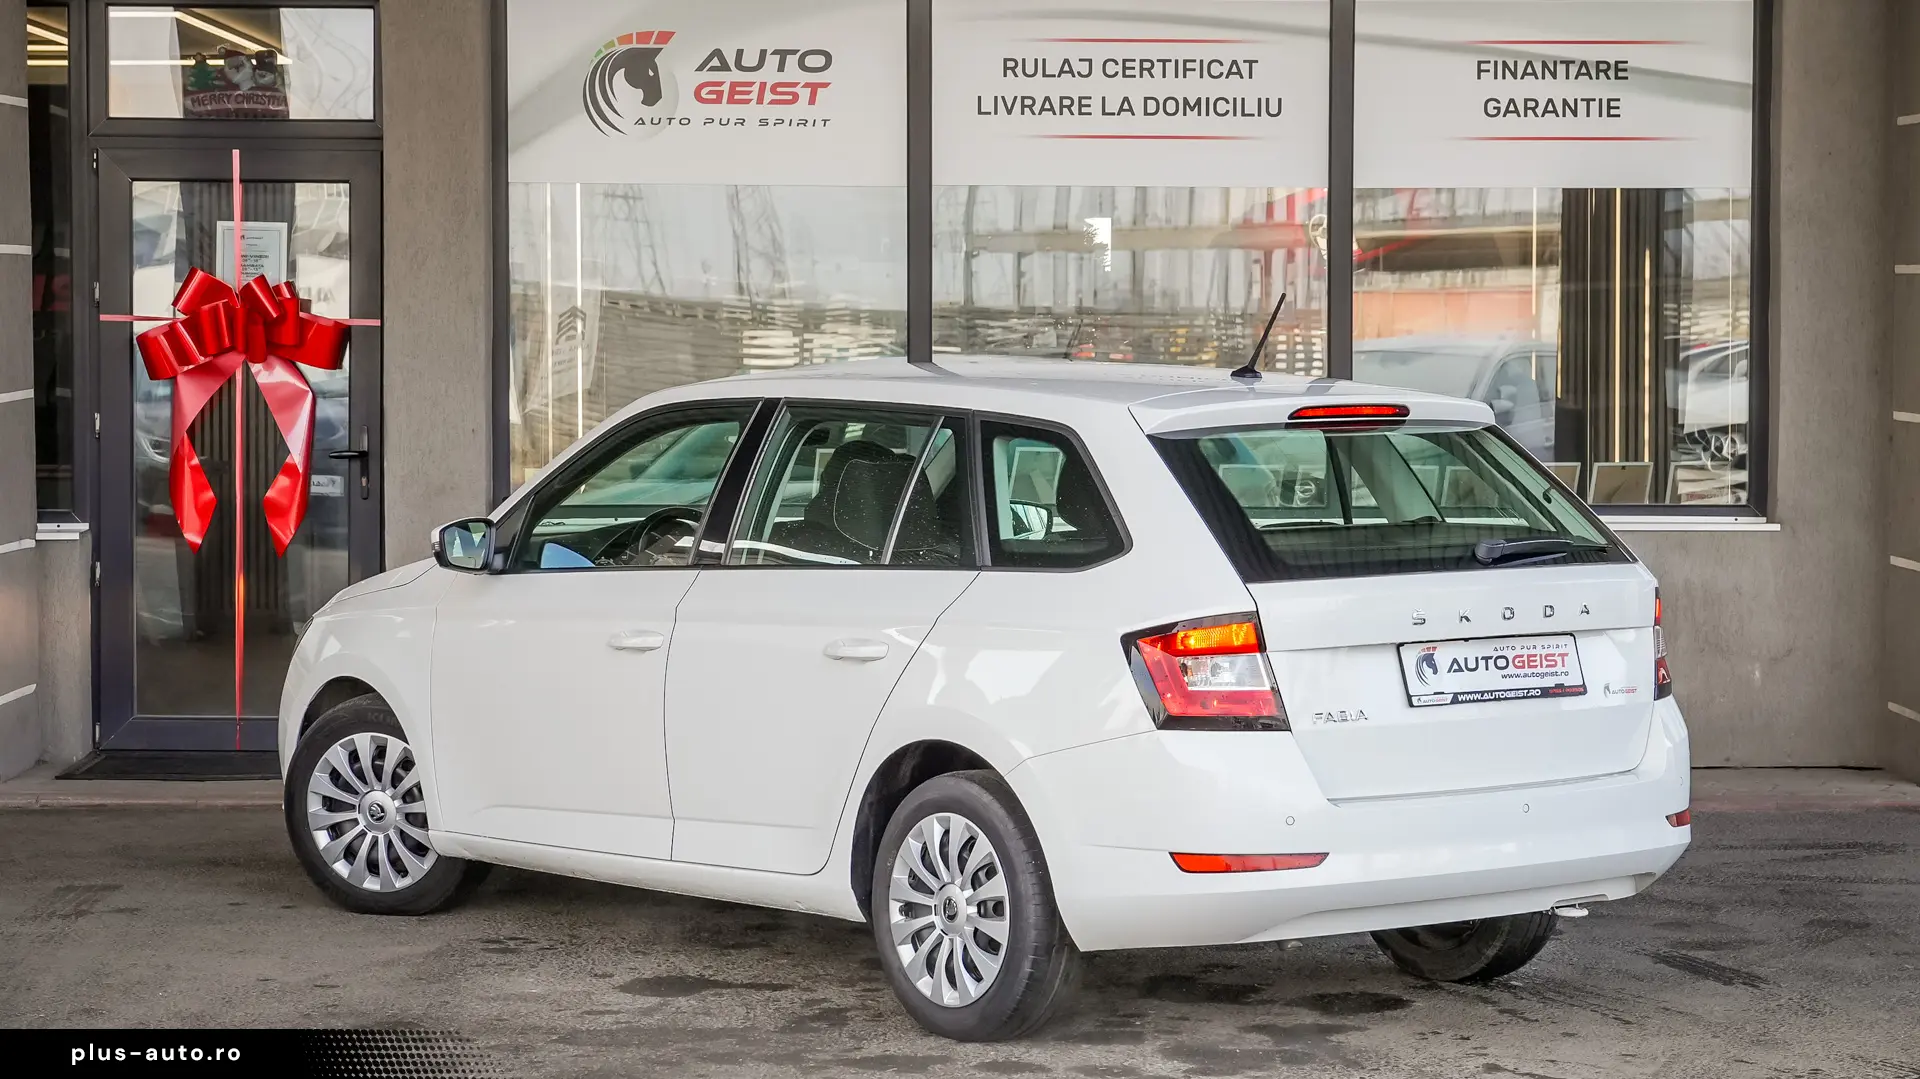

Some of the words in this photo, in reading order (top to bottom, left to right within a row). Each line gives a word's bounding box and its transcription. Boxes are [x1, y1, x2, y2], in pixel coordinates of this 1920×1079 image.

[694, 48, 833, 73] AUTO
[1003, 57, 1093, 78] RULAJ
[1101, 58, 1259, 79] CERTIFICAT
[1476, 60, 1629, 80] FINANTARE
[190, 94, 232, 107] MERRY
[693, 81, 832, 105] GEIST
[977, 95, 1092, 116] LIVRARE
[1101, 96, 1136, 116] LA
[1143, 96, 1283, 118] DOMICILIU
[1483, 97, 1621, 118] GARANTIE
[634, 117, 691, 126] AUTO
[703, 117, 746, 126] PUR
[758, 118, 831, 127] SPIRIT
[1446, 652, 1570, 673] AUTOGEIST
[1501, 671, 1570, 680] www.autogeist.ro
[1457, 688, 1542, 702] WWW.AUTOGEIST.RO
[1312, 709, 1369, 725] FABIA
